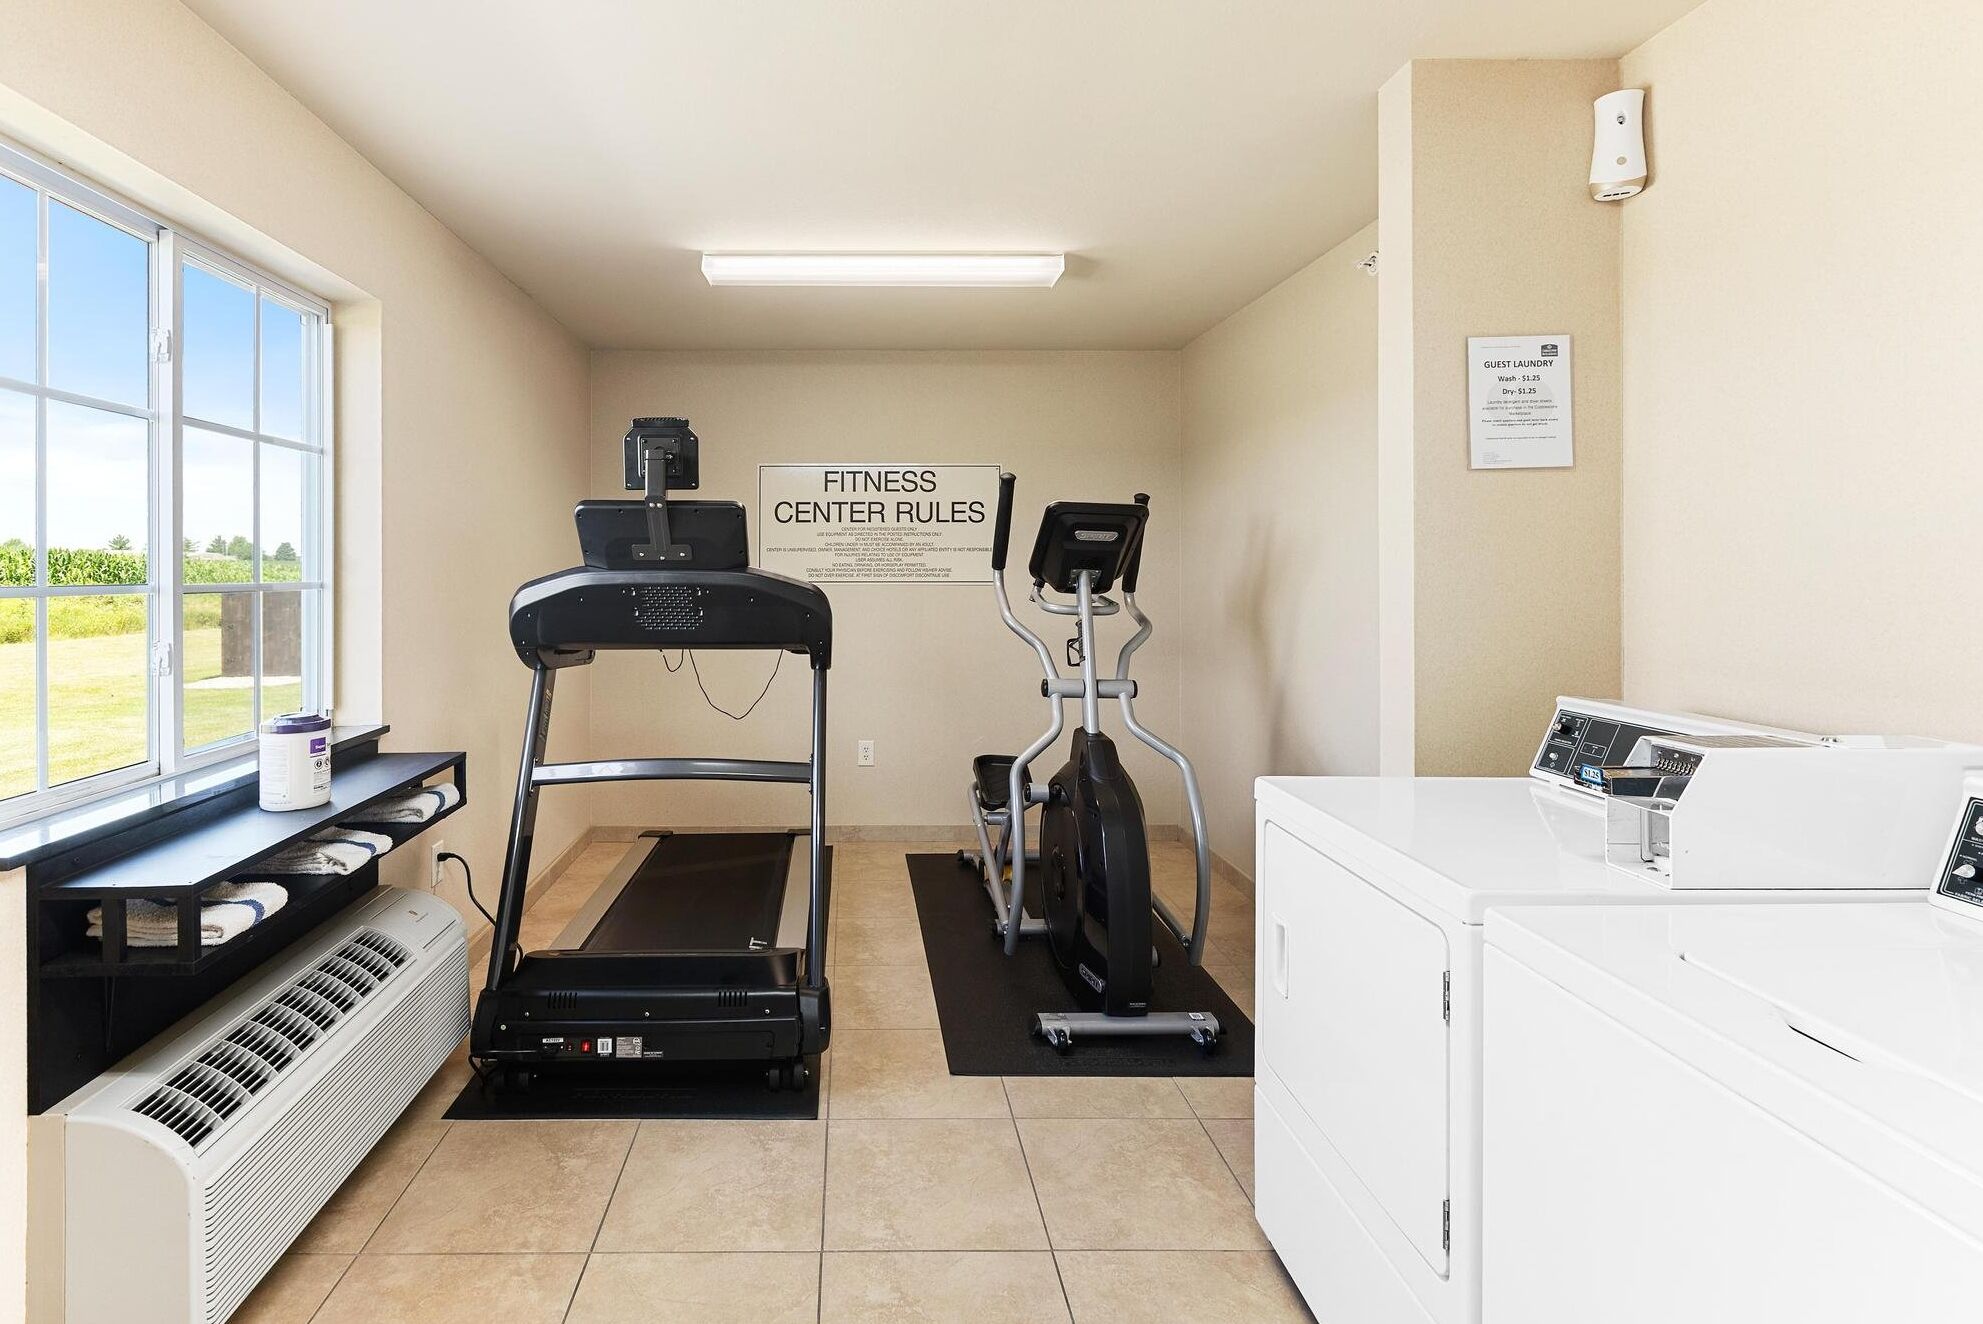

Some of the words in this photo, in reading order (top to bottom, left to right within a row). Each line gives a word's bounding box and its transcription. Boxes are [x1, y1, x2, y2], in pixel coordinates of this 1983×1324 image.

[1484, 360, 1511, 368] GUEST
[1514, 360, 1554, 368] LAUNDRY
[824, 470, 936, 492] FITNESS
[774, 501, 886, 523] CENTER
[896, 501, 985, 523] RULES
[1584, 768, 1600, 780] $1.25
